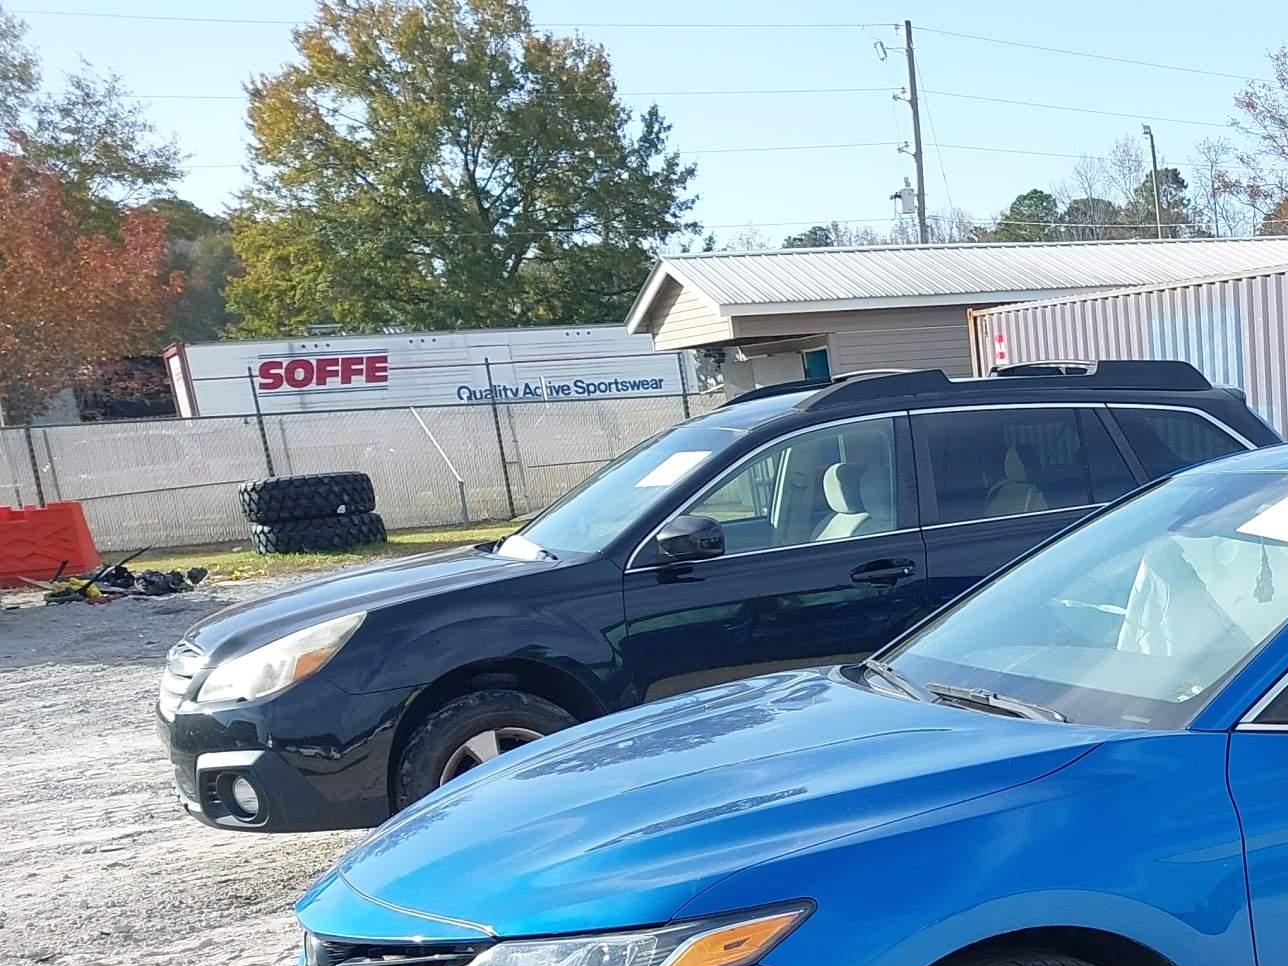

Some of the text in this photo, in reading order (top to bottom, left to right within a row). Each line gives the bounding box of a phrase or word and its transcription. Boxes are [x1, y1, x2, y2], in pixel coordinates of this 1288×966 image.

[258, 354, 389, 391] SOFFE
[522, 380, 571, 398] Acive
[573, 376, 665, 397] Sportswear
